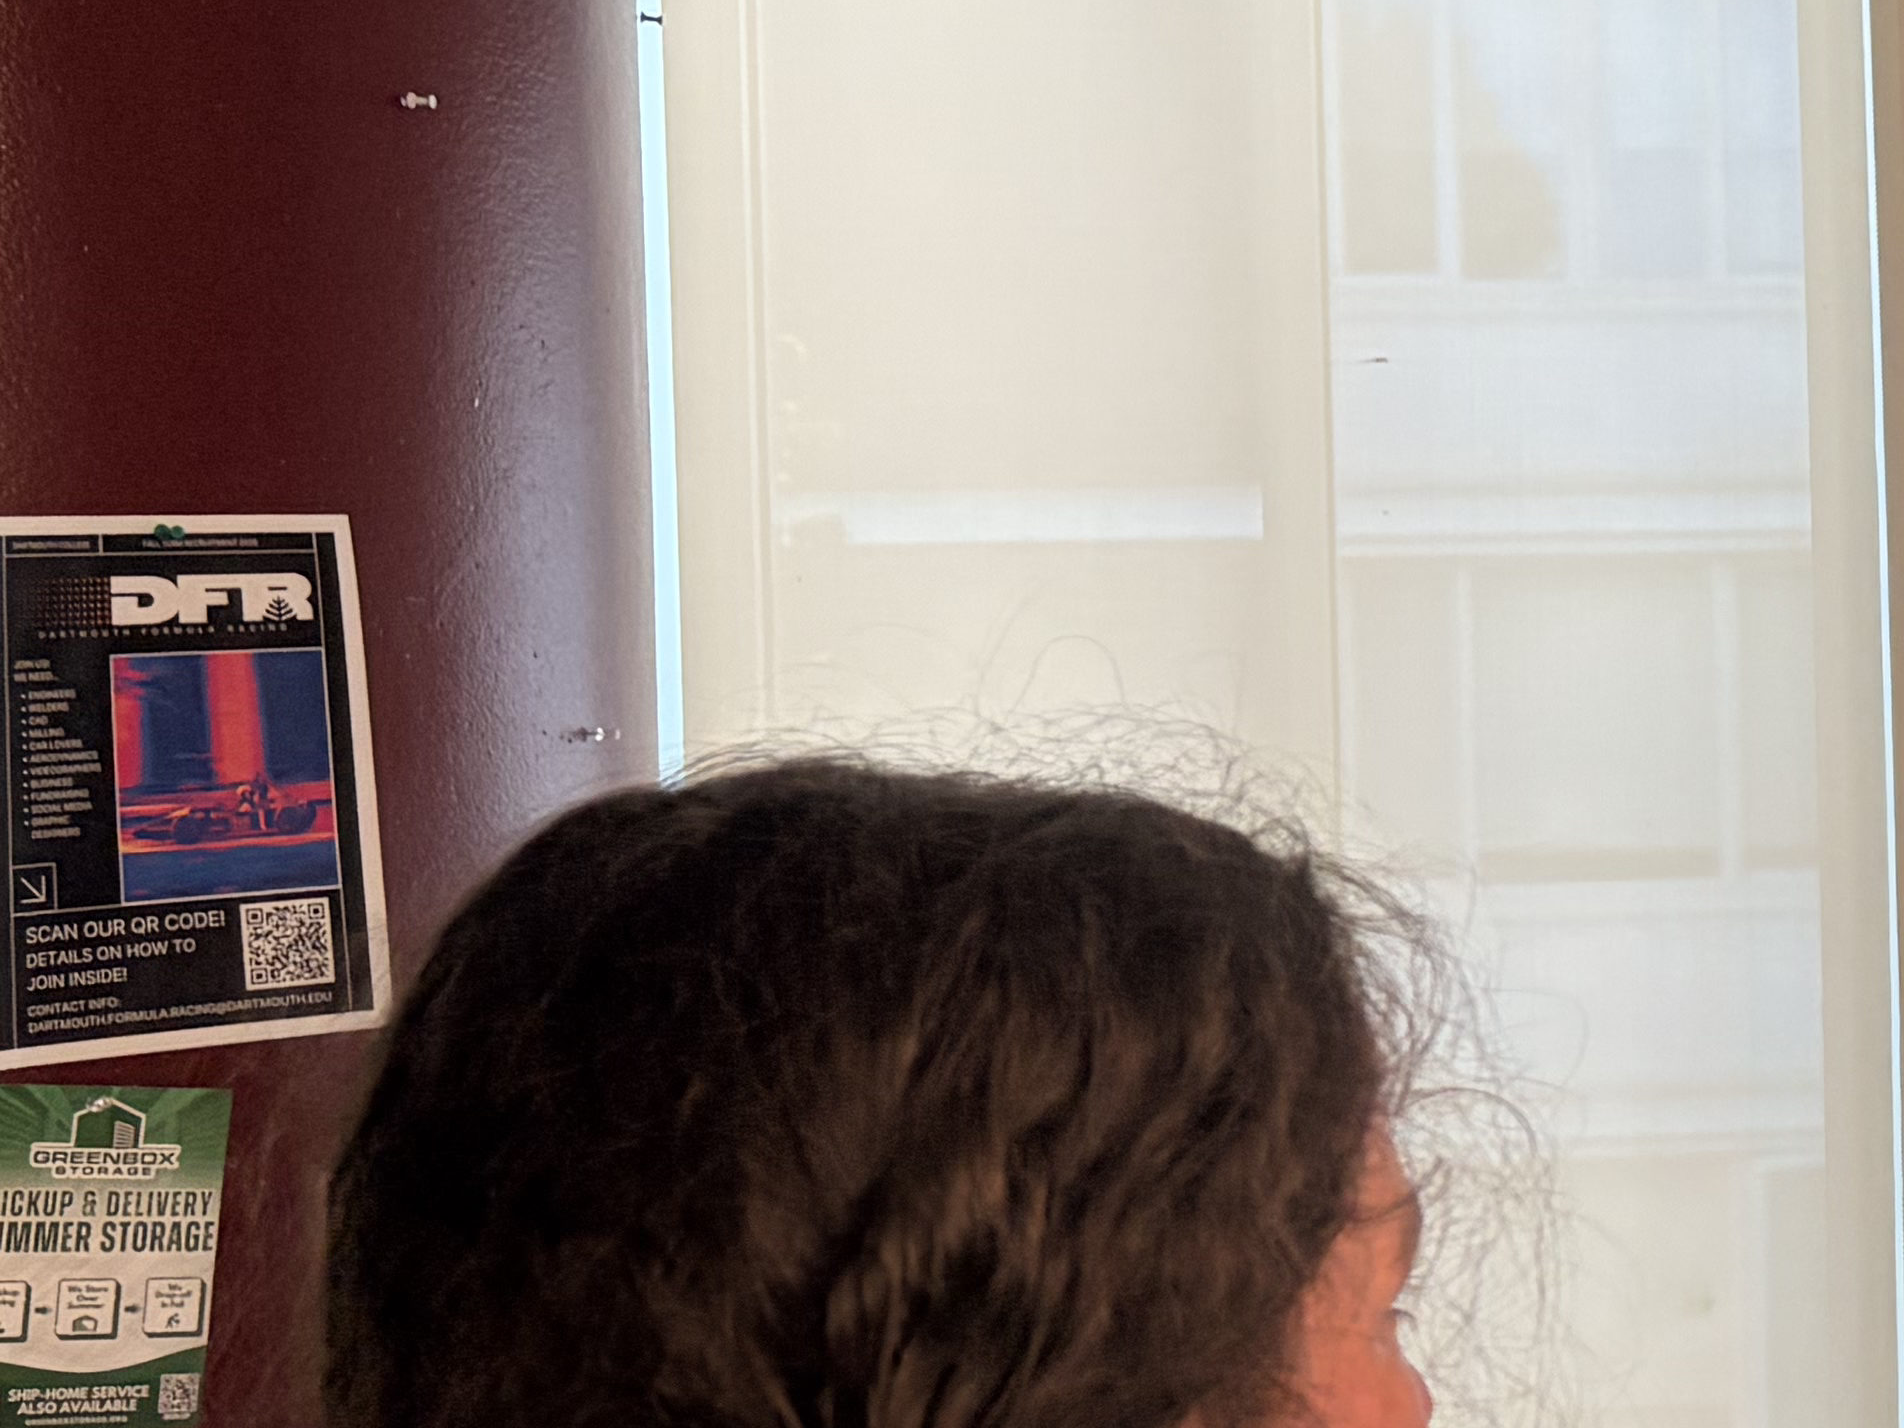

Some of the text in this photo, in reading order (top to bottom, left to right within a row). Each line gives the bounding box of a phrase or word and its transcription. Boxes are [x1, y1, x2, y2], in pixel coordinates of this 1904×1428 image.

[110, 572, 314, 625] DFR
[26, 910, 225, 944] SCAN OUR QR CODE!
[26, 938, 196, 969] DETAILS ON HOW TO
[27, 967, 128, 992] JOIN INSIDE!
[27, 999, 86, 1018] CONTACT
[33, 1151, 175, 1165] GREENBOX
[55, 1166, 151, 1176] STORAGE
[0, 1190, 213, 1217] ICKUP & DELIVERY
[0, 1221, 215, 1253] MMER STORAGE
[8, 1385, 150, 1402] SHIP-HOME SERVICE
[17, 1399, 138, 1415] ALSO AVAILABLE
